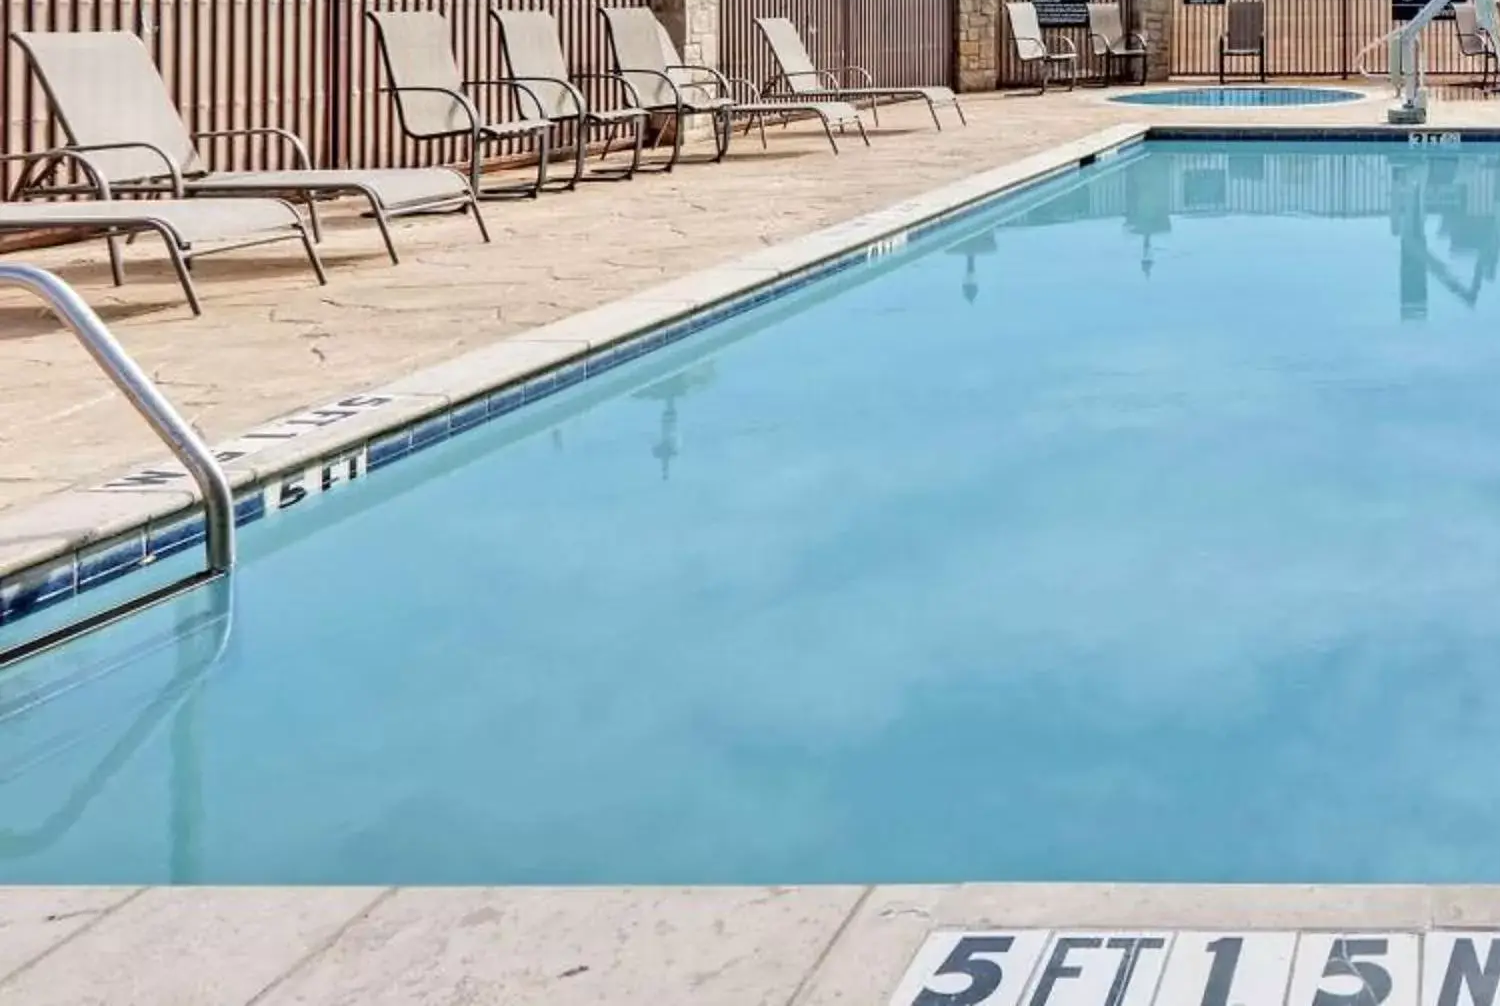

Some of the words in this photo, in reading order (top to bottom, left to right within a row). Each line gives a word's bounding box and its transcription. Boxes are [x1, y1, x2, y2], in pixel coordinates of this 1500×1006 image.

[279, 478, 308, 509] 5
[321, 457, 357, 492] FT
[911, 936, 1016, 1006] 5
[1029, 937, 1165, 1006] FT
[1200, 937, 1244, 1006] 1
[1311, 939, 1393, 1006] 5
